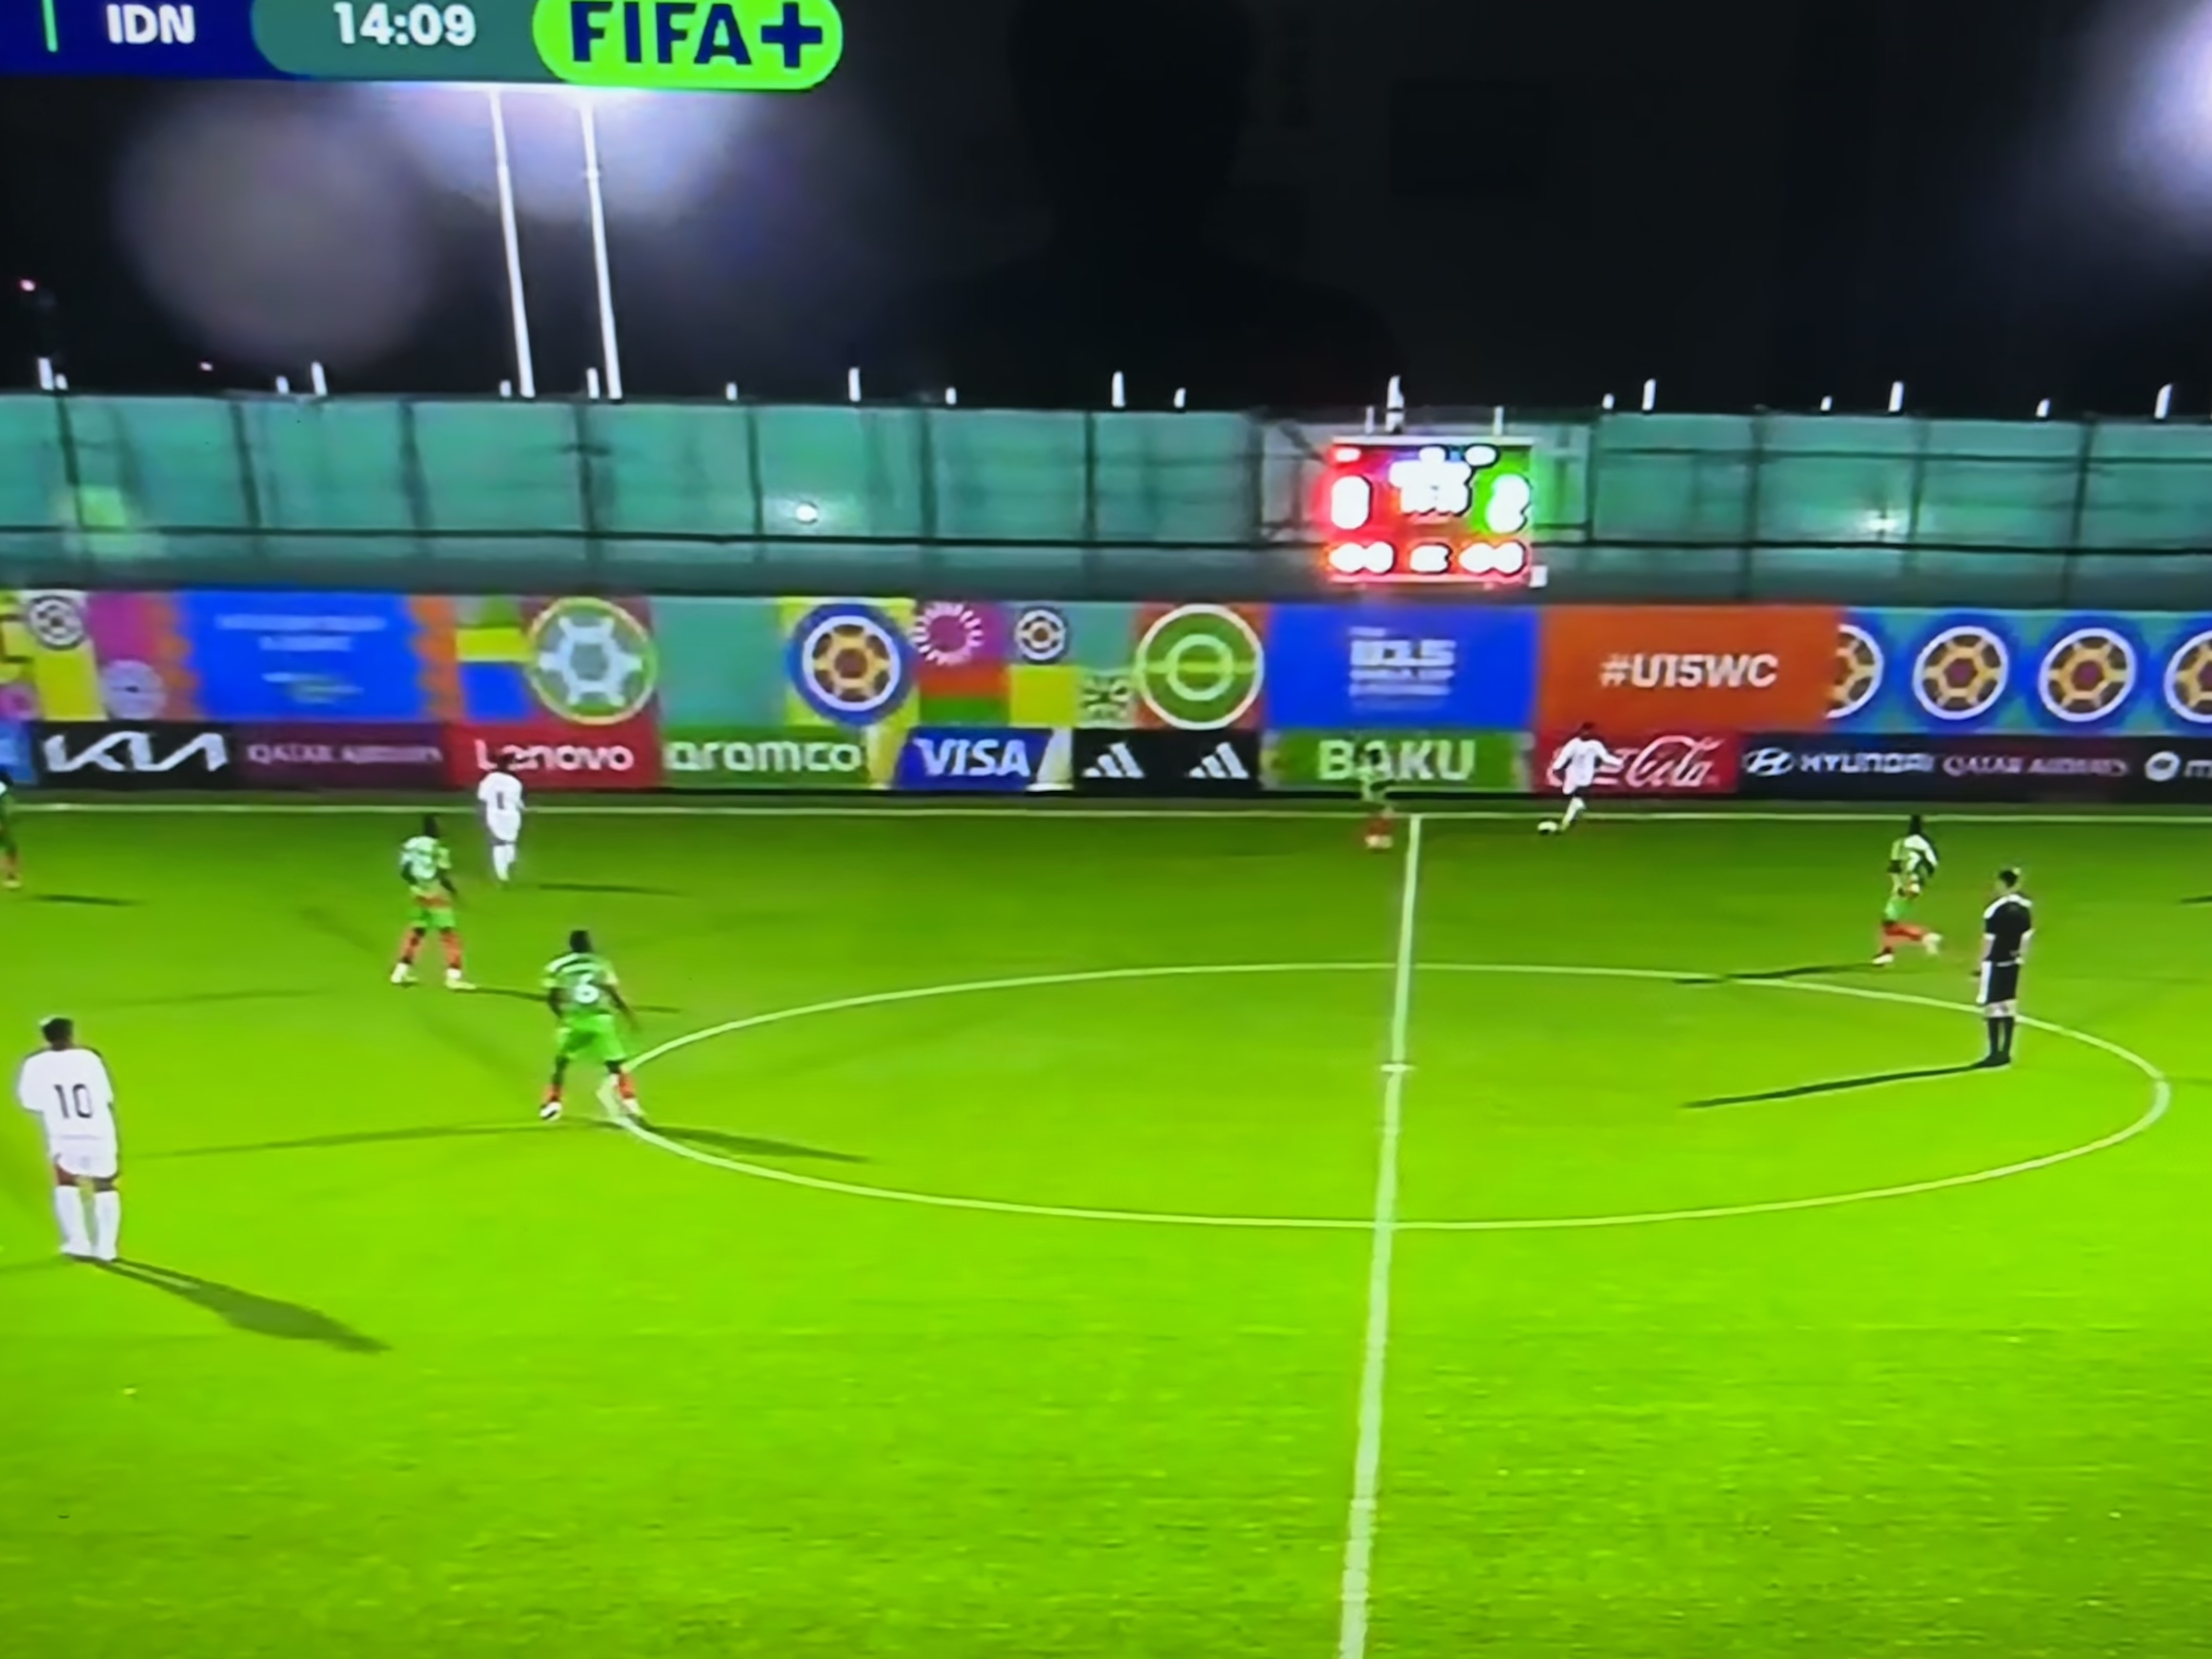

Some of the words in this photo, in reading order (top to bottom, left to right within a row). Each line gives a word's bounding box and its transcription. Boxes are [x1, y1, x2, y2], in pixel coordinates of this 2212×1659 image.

[106, 3, 195, 44] IDN
[333, 2, 476, 46] 14:09
[571, 1, 823, 68] FIFA+
[1600, 653, 1778, 688] #U15WC
[44, 730, 228, 771] KIA
[665, 740, 862, 771] aramco
[913, 738, 1030, 777] VISA
[53, 1084, 93, 1118] 10
